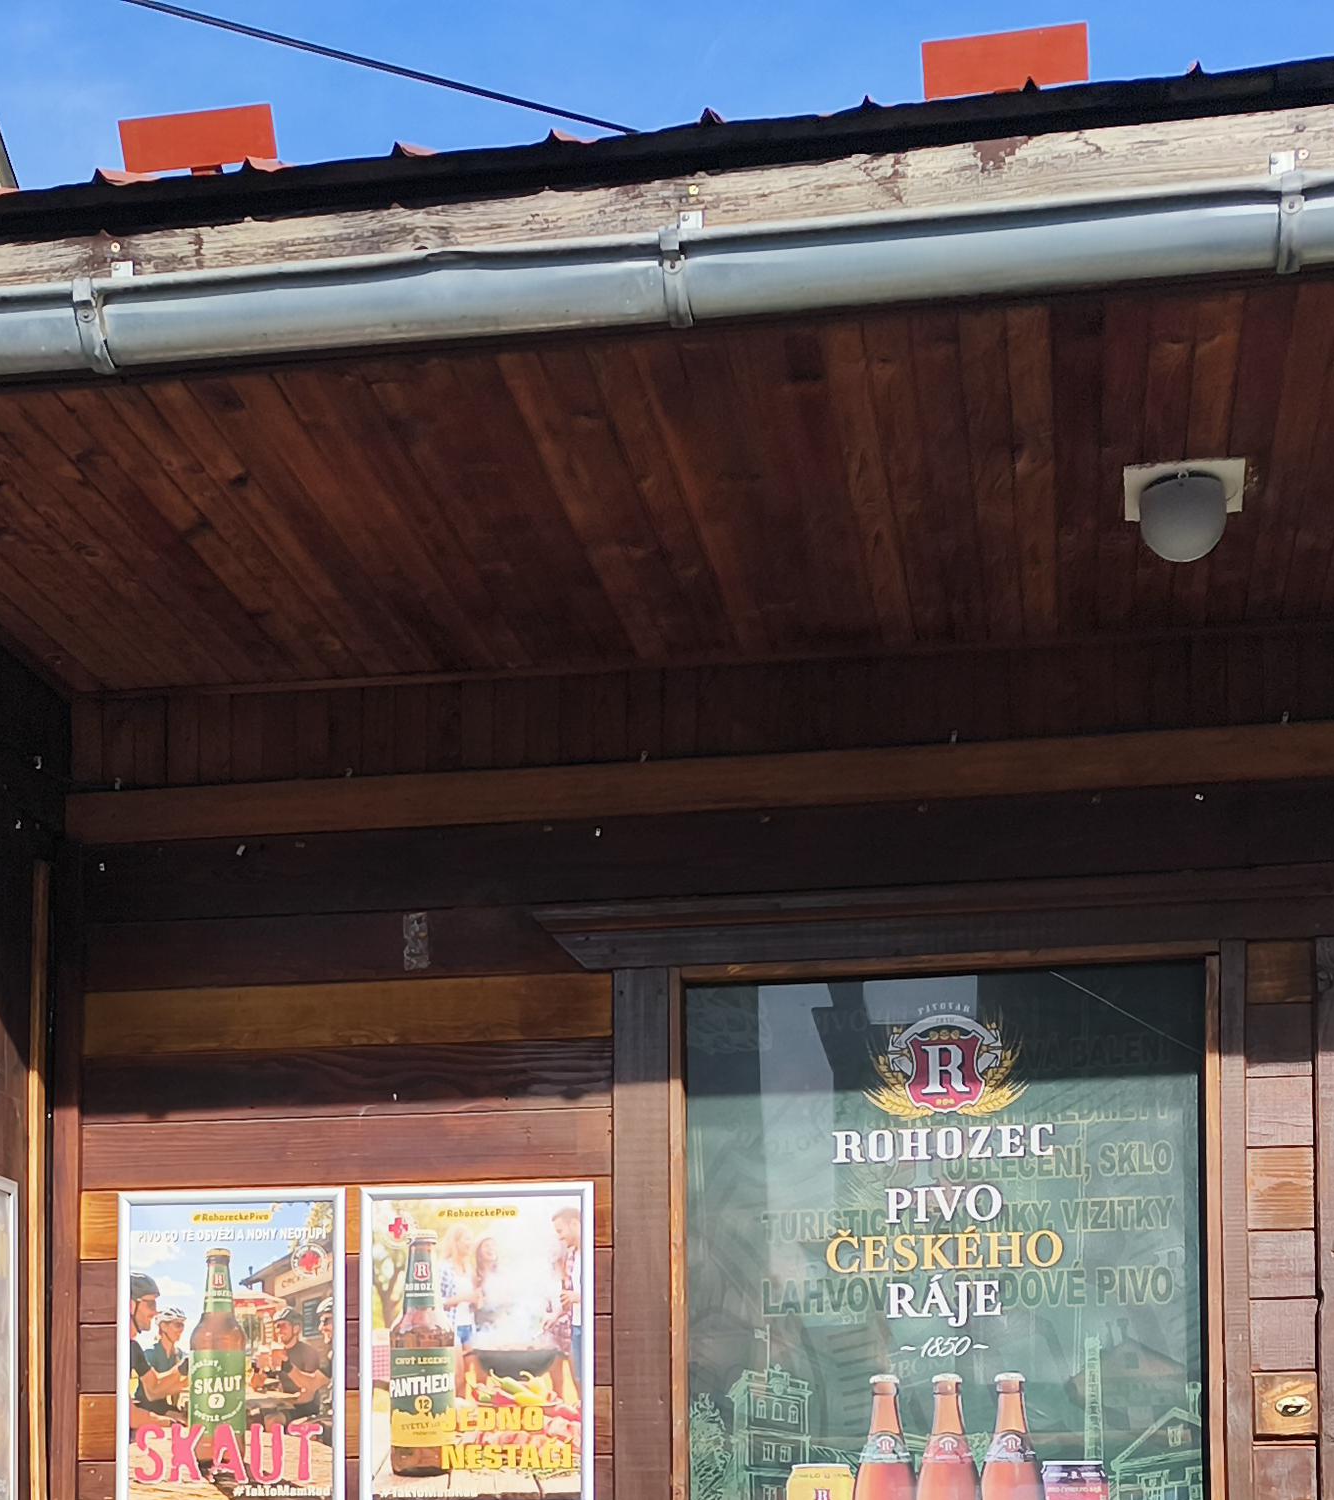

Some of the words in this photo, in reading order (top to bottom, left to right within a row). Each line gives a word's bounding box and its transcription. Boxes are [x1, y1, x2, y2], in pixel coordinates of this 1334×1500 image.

[831, 1123, 1055, 1164] ROHOZEC
[1098, 1140, 1175, 1177] SKLO
[884, 1184, 1004, 1224] PIVO
[1060, 1196, 1175, 1232] VIZITKY
[138, 1231, 163, 1244] PIVO
[165, 1231, 179, 1243] CO
[237, 1229, 245, 1241] A
[246, 1228, 277, 1242] NOHY
[280, 1224, 328, 1241] NEOTUPÍ
[825, 1225, 1064, 1274] ČESKÉHO
[886, 1273, 1002, 1328] RÁJE
[1095, 1265, 1175, 1308] PIVO
[193, 1375, 242, 1395] SKAUT
[418, 1398, 430, 1409] 12
[441, 1406, 545, 1433] JEDNO
[134, 1423, 324, 1485] SKAUT
[440, 1437, 574, 1471] NESTAČÍ
